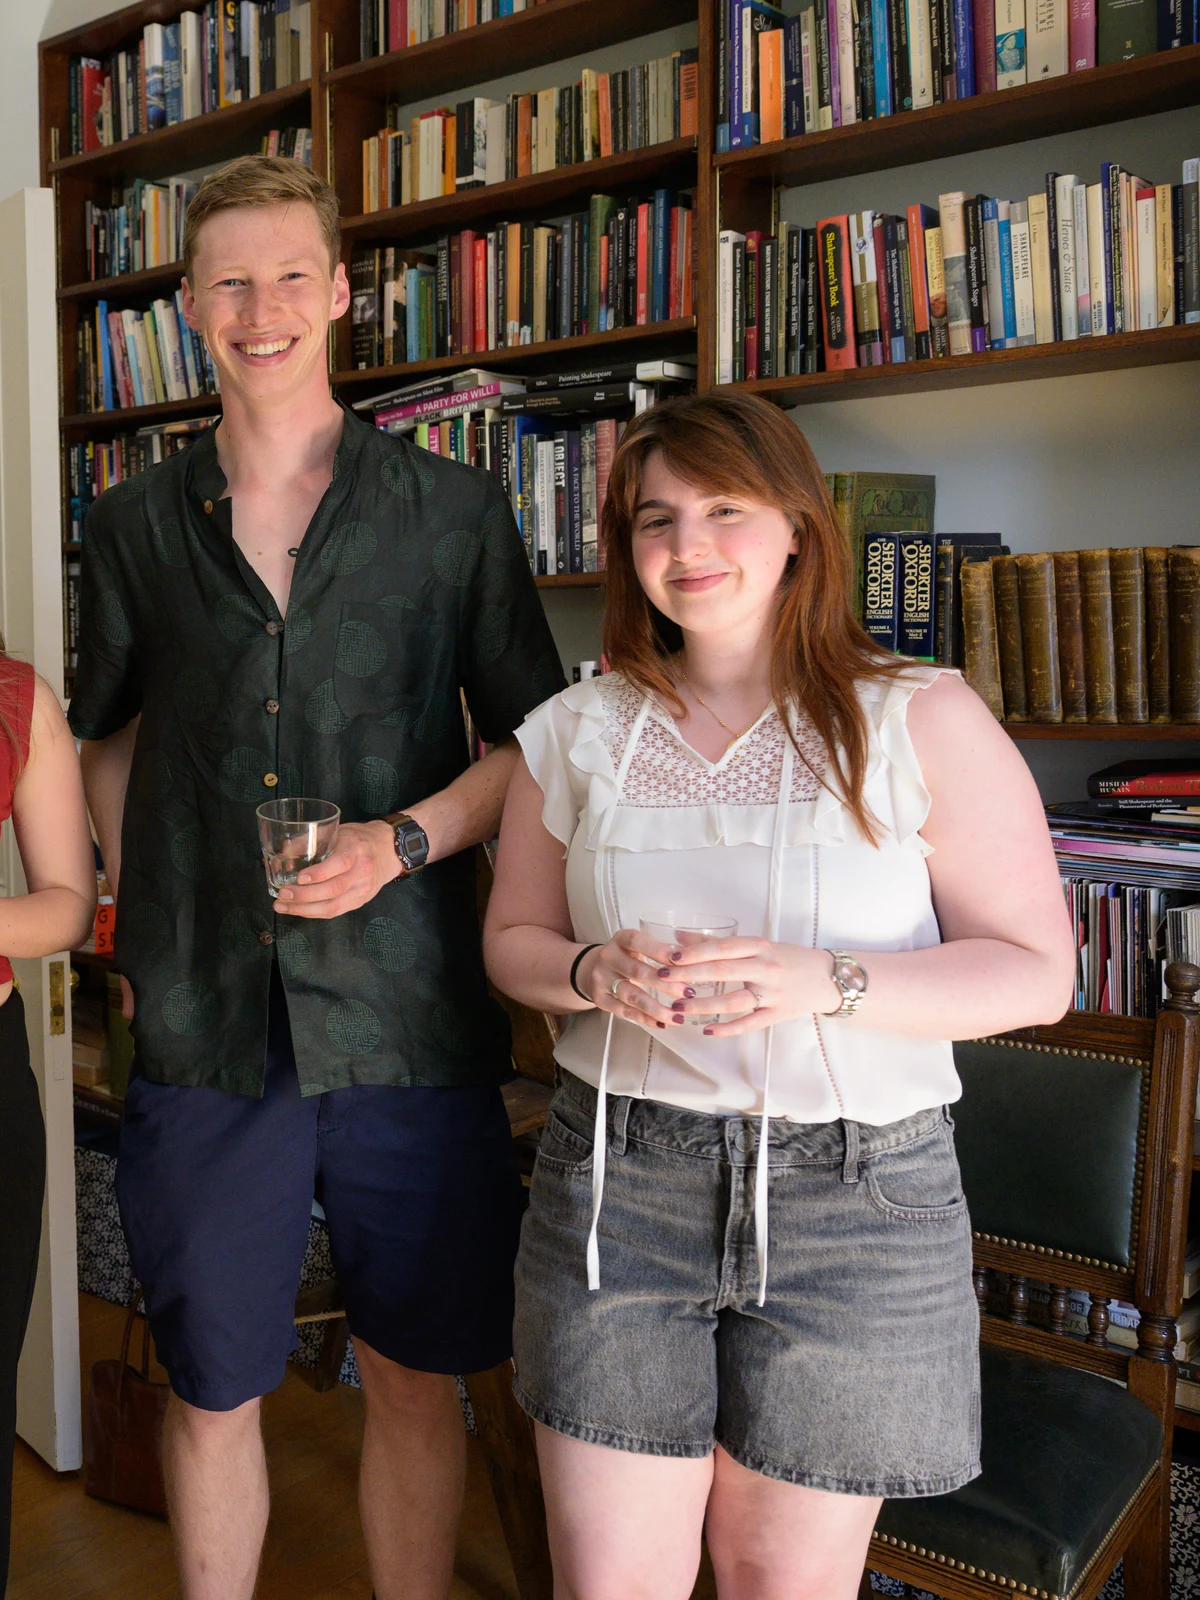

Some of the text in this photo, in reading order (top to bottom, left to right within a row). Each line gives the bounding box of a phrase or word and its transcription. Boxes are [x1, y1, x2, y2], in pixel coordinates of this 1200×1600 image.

[1061, 219, 1072, 250] Heroes
[826, 232, 839, 307] Shakespeare's Book
[969, 246, 977, 281] Shakespeare
[1019, 233, 1029, 279] SHAKESPEARE
[807, 262, 815, 296] Shakespeare
[891, 258, 899, 293] Shakespearean
[1004, 257, 1012, 299] shakespeare
[1063, 266, 1074, 294] States
[971, 289, 979, 307] Stages
[580, 370, 612, 380] Shakespeare
[393, 393, 416, 404] Shakespeare
[413, 412, 442, 424] BLACK
[443, 402, 478, 417] BRITAIN
[423, 399, 449, 412] PARTY
[451, 393, 469, 404] FOR
[470, 385, 494, 399] WILL!
[554, 446, 565, 487] OBJECT
[867, 542, 881, 609] OXFORD
[881, 542, 895, 608] SHORTER
[904, 545, 918, 612] OXFORD
[918, 544, 932, 611] SHORTER
[98, 909, 108, 923] G
